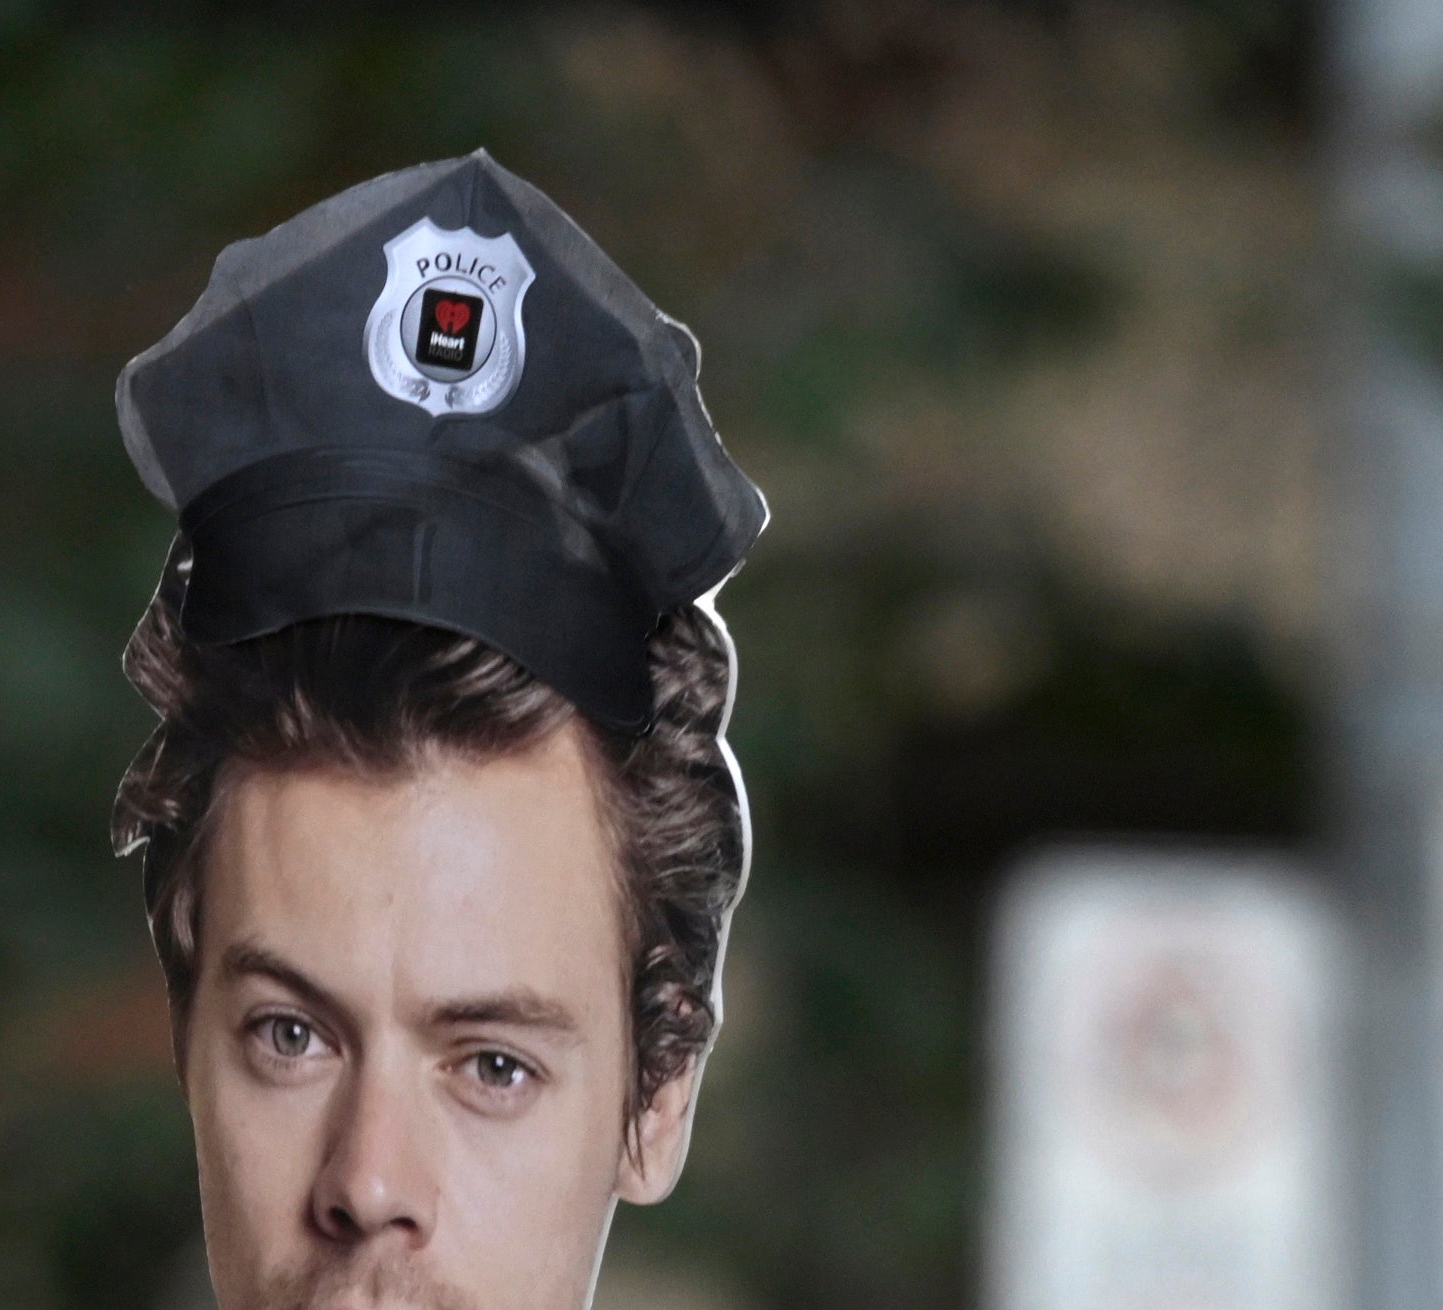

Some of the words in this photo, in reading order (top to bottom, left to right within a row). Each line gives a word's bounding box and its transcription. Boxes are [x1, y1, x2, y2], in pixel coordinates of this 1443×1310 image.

[416, 252, 507, 295] POLICE
[429, 331, 466, 350] iHeart
[427, 346, 464, 362] RADIO
